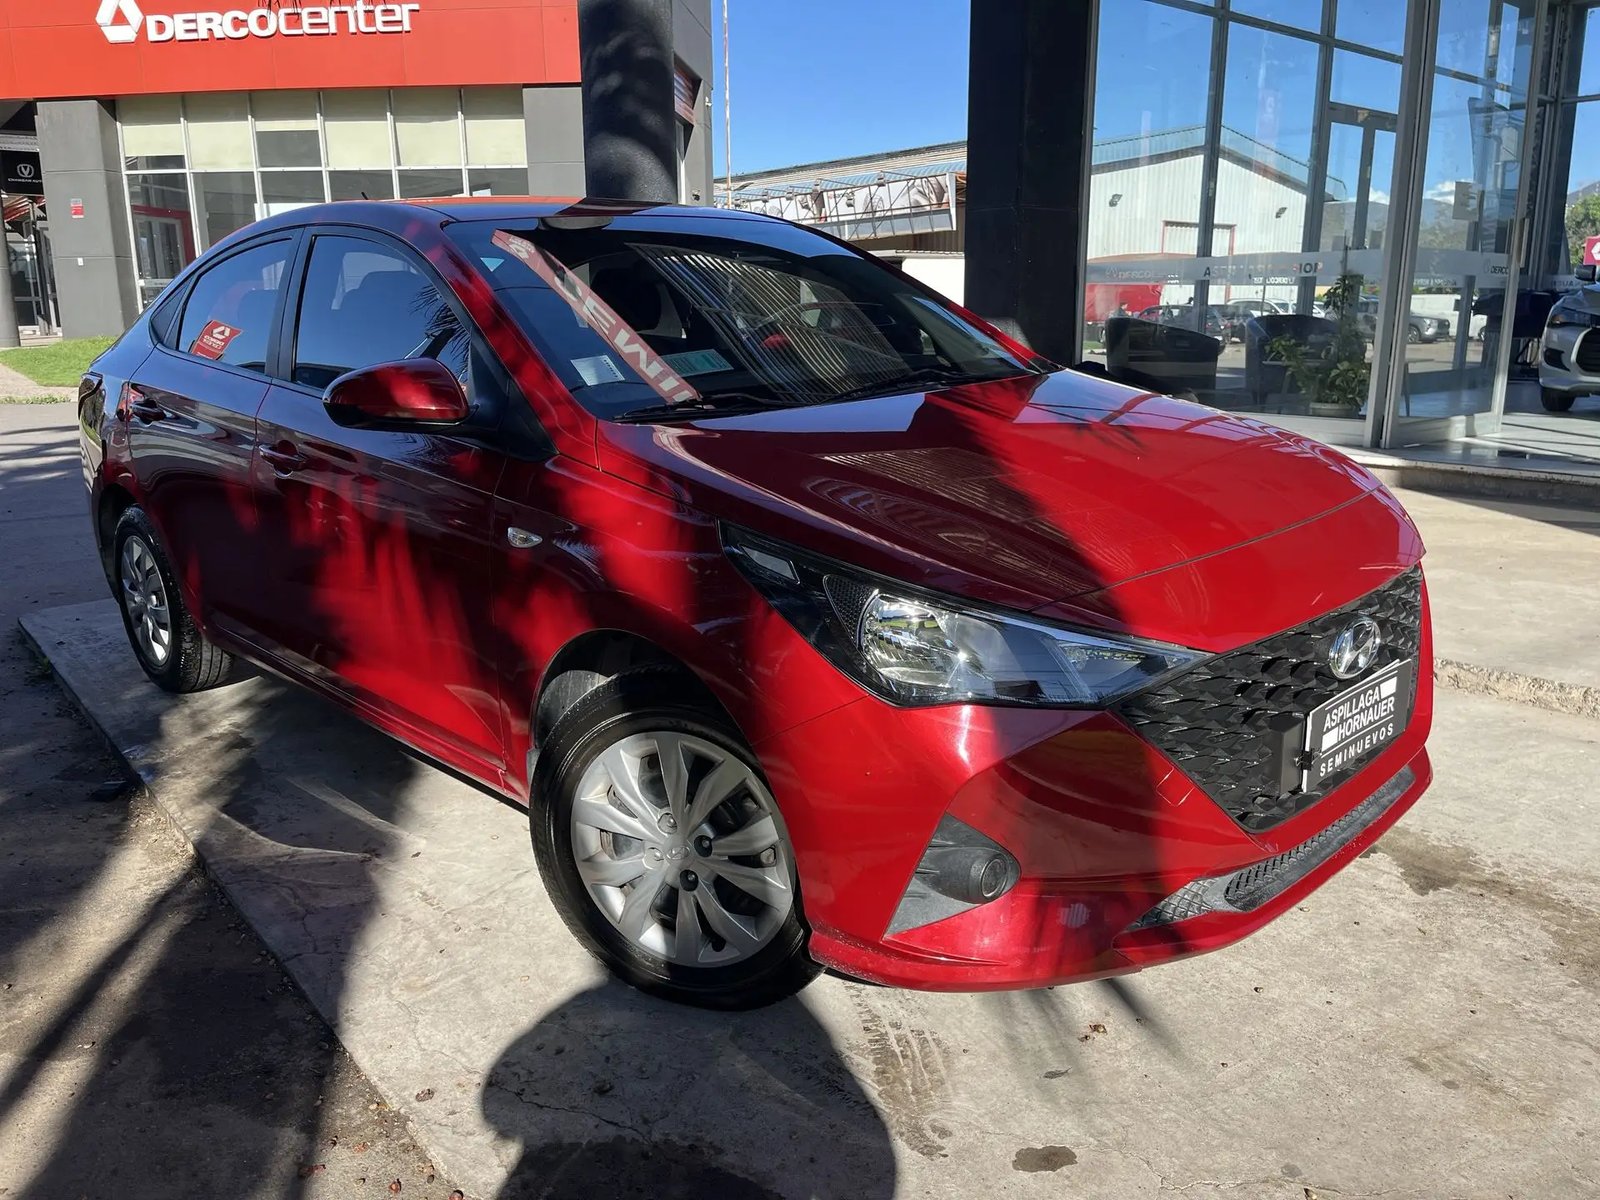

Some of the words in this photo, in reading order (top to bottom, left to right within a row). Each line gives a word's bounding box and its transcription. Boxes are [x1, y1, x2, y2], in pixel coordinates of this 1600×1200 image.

[1323, 686, 1380, 732] ASPILLAGA
[1337, 697, 1395, 741] HORNAUER
[1320, 722, 1394, 777] SEMINUEVOS
